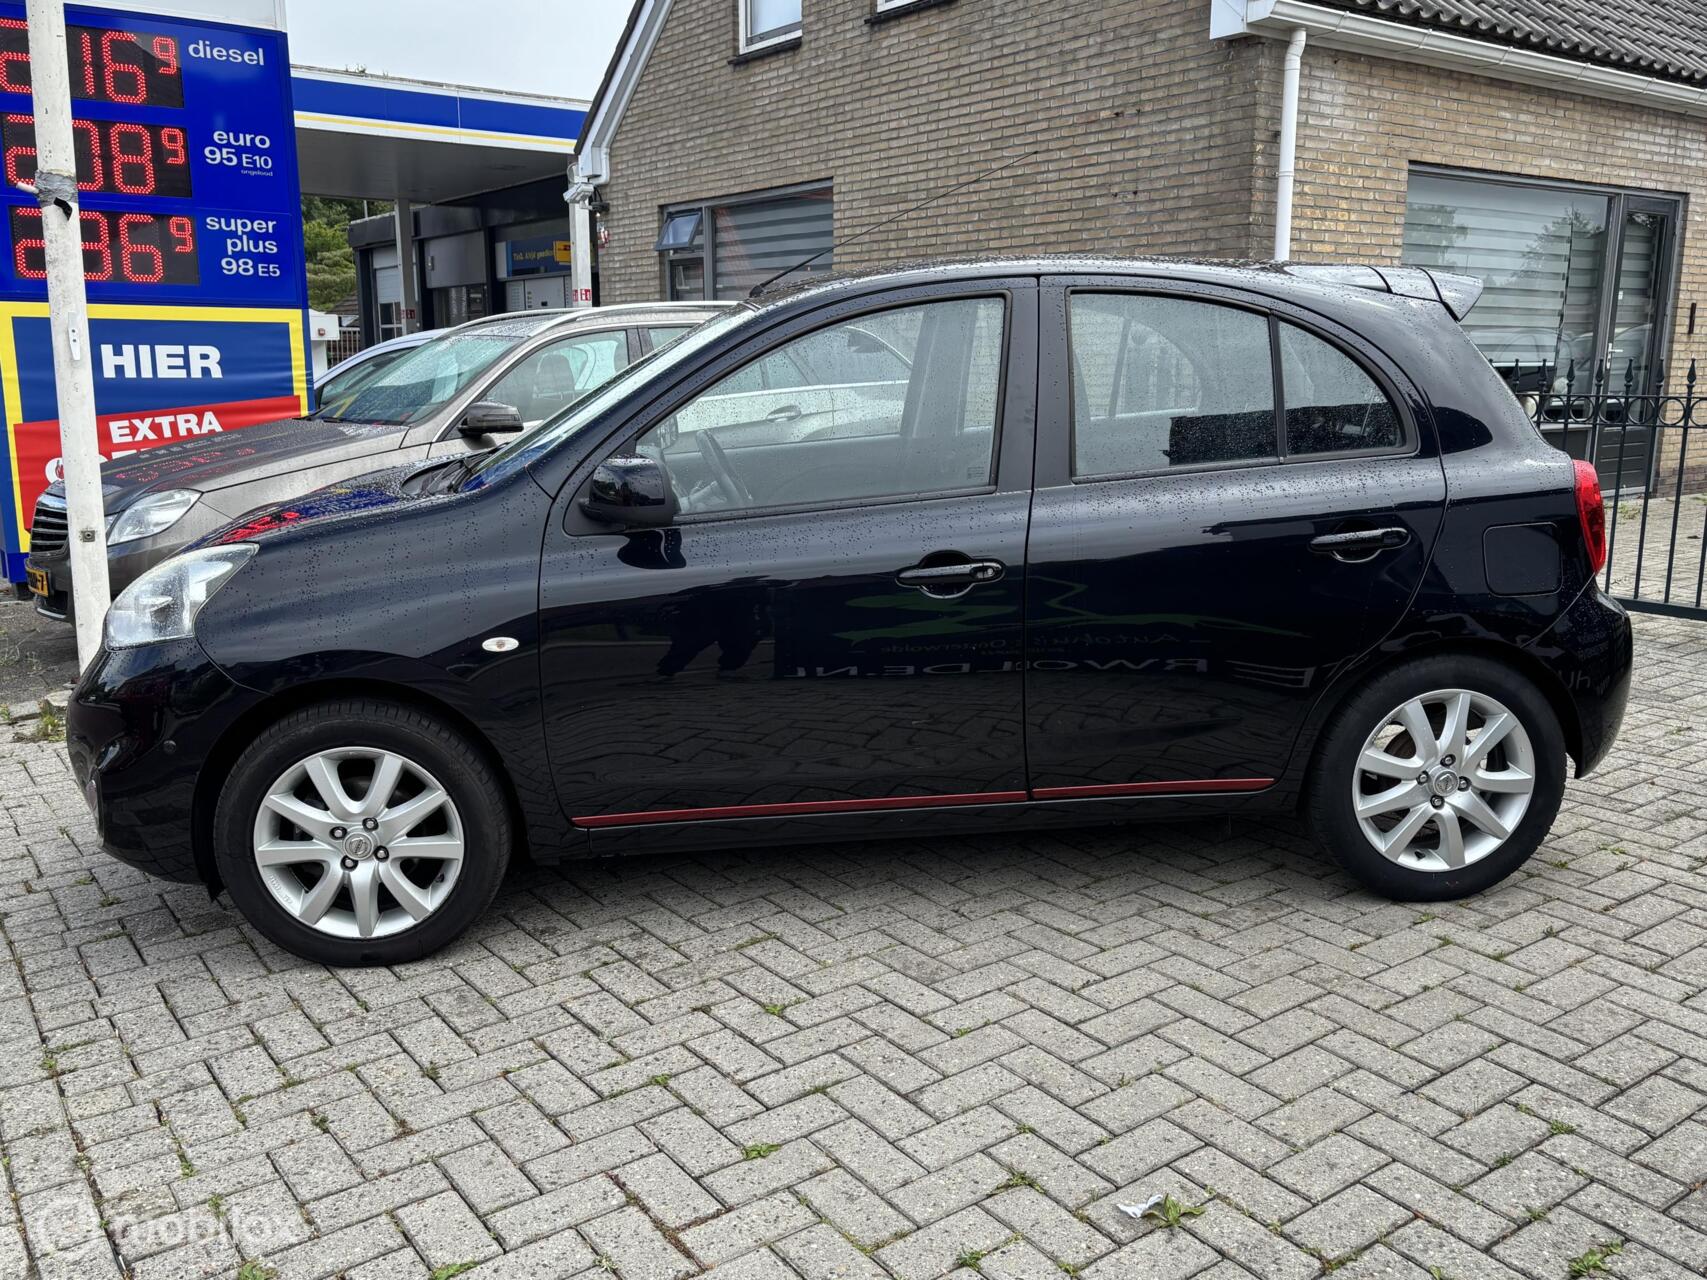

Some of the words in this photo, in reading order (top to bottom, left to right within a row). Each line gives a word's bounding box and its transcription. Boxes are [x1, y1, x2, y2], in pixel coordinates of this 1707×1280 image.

[187, 39, 265, 66] diesel
[213, 130, 271, 149] euro
[204, 146, 238, 166] 95
[242, 153, 272, 169] E10
[205, 216, 277, 236] super
[226, 234, 278, 255] plus
[221, 257, 254, 276] 98
[258, 263, 280, 277] E5
[100, 344, 223, 379] HIER
[108, 411, 223, 444] EXTRA
